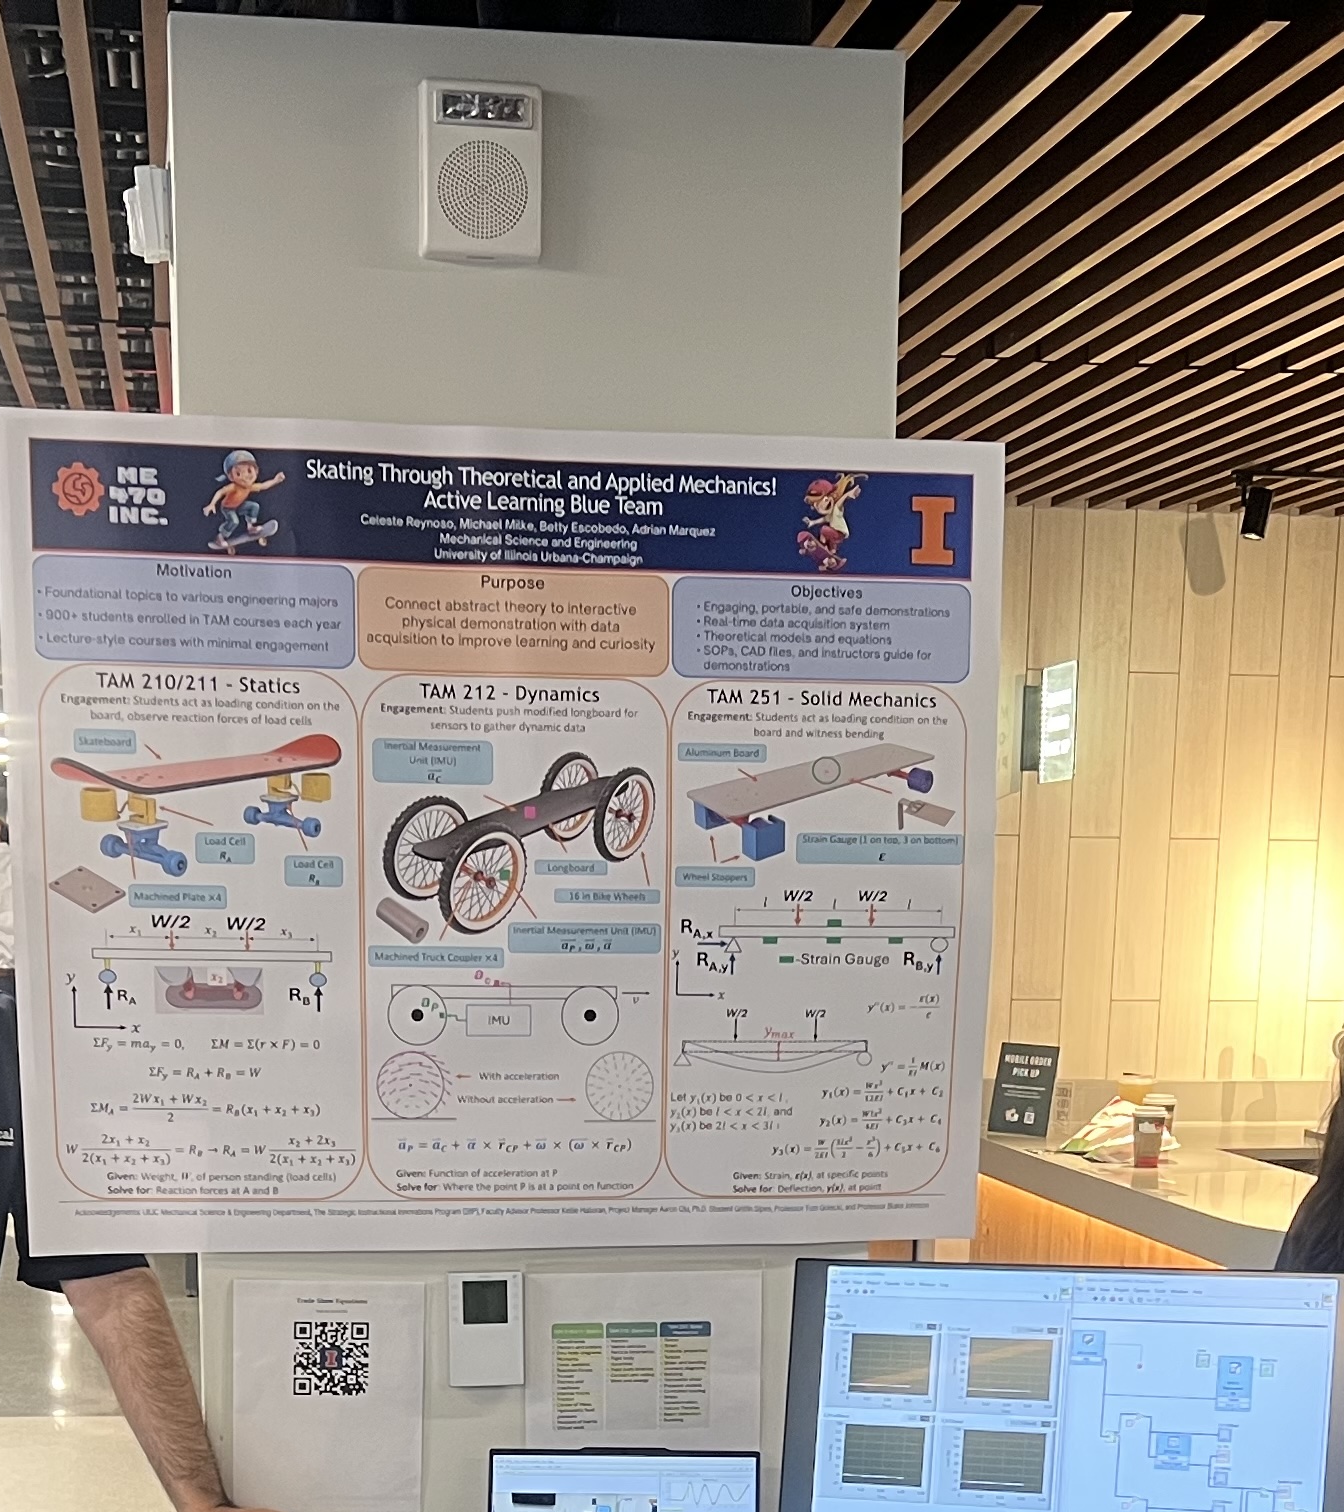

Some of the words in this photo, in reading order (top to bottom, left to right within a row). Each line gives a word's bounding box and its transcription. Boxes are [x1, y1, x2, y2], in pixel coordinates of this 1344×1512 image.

[116, 466, 158, 485] ME
[306, 459, 374, 485] Skating
[377, 462, 453, 489] Through
[457, 466, 562, 489] Theoretical
[567, 471, 601, 490] and
[604, 472, 674, 495] Applied
[678, 475, 776, 495] Mechanics!
[109, 486, 167, 505] 470
[423, 490, 482, 509] Active
[487, 491, 565, 517] Learning
[570, 494, 610, 514] Blue
[614, 495, 663, 515] Team
[109, 506, 169, 526] INC.
[360, 513, 403, 526] Celeste
[405, 515, 457, 530] Reynoso,
[459, 517, 502, 530] Michael
[539, 520, 568, 535] Betty
[571, 521, 629, 535] Escobedo,
[631, 523, 666, 535] Adrian
[668, 524, 715, 537] Marquez
[439, 532, 502, 545] Mechanical
[504, 533, 548, 546] Science
[551, 536, 571, 547] and
[573, 536, 637, 551] Engineering
[434, 547, 488, 562] University
[489, 548, 502, 560] of
[504, 549, 538, 561] Illinois
[540, 551, 643, 566] Urbana-Champaign
[156, 563, 231, 578] Motivation
[480, 574, 544, 591] Purpose
[44, 585, 122, 599] Foundational
[125, 589, 162, 602] topics
[165, 590, 178, 602] to
[181, 591, 224, 603] various
[226, 595, 296, 608] engineering
[298, 596, 338, 608] majors
[790, 584, 862, 600] Objectives
[384, 596, 441, 611] Connect
[444, 599, 500, 612] abstract
[504, 600, 546, 616] theory
[550, 601, 564, 614] to
[567, 602, 636, 615] interactive
[703, 600, 758, 615] Engaging,
[761, 603, 812, 615] portable,
[814, 604, 835, 615] and
[838, 604, 862, 615] safe
[864, 605, 950, 617] demonstrations
[45, 608, 77, 620] 900+
[81, 611, 134, 622] students
[136, 613, 186, 624] enrolled
[189, 613, 199, 624] in
[202, 613, 229, 625] TAM
[232, 617, 280, 628] courses
[283, 618, 312, 629] each
[315, 620, 341, 631] year
[401, 615, 456, 630] physical
[459, 617, 556, 630] demonstration
[559, 619, 586, 631] with
[590, 620, 619, 632] data
[703, 615, 756, 627] Real-time
[759, 617, 784, 628] data
[787, 618, 846, 630] acquisition
[849, 620, 890, 632] system
[46, 632, 125, 647] Lecture-style
[128, 636, 176, 647] courses
[179, 636, 204, 647] with
[206, 637, 252, 649] minimal
[255, 640, 328, 653] engagement
[366, 631, 437, 646] acquisition
[441, 633, 454, 646] to
[458, 633, 512, 649] improve
[515, 634, 568, 651] learning
[571, 636, 596, 649] and
[599, 637, 655, 653] curiosity
[703, 629, 767, 642] Theoretical
[769, 632, 812, 643] models
[814, 633, 835, 644] and
[837, 634, 892, 646] equations
[703, 644, 737, 657] SOPs,
[740, 645, 766, 656] CAD
[768, 645, 795, 658] files,
[797, 647, 818, 658] and
[821, 647, 880, 659] instructors
[883, 648, 913, 661] guide
[916, 649, 931, 660] for
[703, 660, 790, 671] demonstrations
[95, 672, 134, 688] TAM
[141, 673, 216, 691] 210/211
[239, 676, 300, 693] Statics
[418, 682, 456, 699] TAM
[463, 684, 495, 700] 212
[515, 685, 599, 704] Dynamics
[706, 688, 743, 704] TAM
[749, 689, 779, 705] 251
[800, 690, 842, 706] Solid
[848, 691, 936, 708] Mechanics
[687, 710, 752, 722] Engagement:
[755, 711, 798, 722] Students
[801, 713, 816, 722] act
[818, 714, 829, 722] as
[831, 713, 867, 725] loading
[869, 714, 914, 724] condition
[932, 715, 948, 725] the
[753, 727, 782, 737] board
[785, 727, 803, 737] and
[805, 729, 842, 738] witness
[845, 728, 884, 740] bending
[547, 863, 597, 875] Longboard
[151, 915, 191, 929] W/2
[226, 917, 266, 931] W/2
[487, 1015, 510, 1025] IMU
[1004, 1054, 1029, 1065] MOBILE
[1030, 1056, 1052, 1067] ORDER
[1012, 1067, 1029, 1077] PICK
[1029, 1069, 1040, 1078] UP
